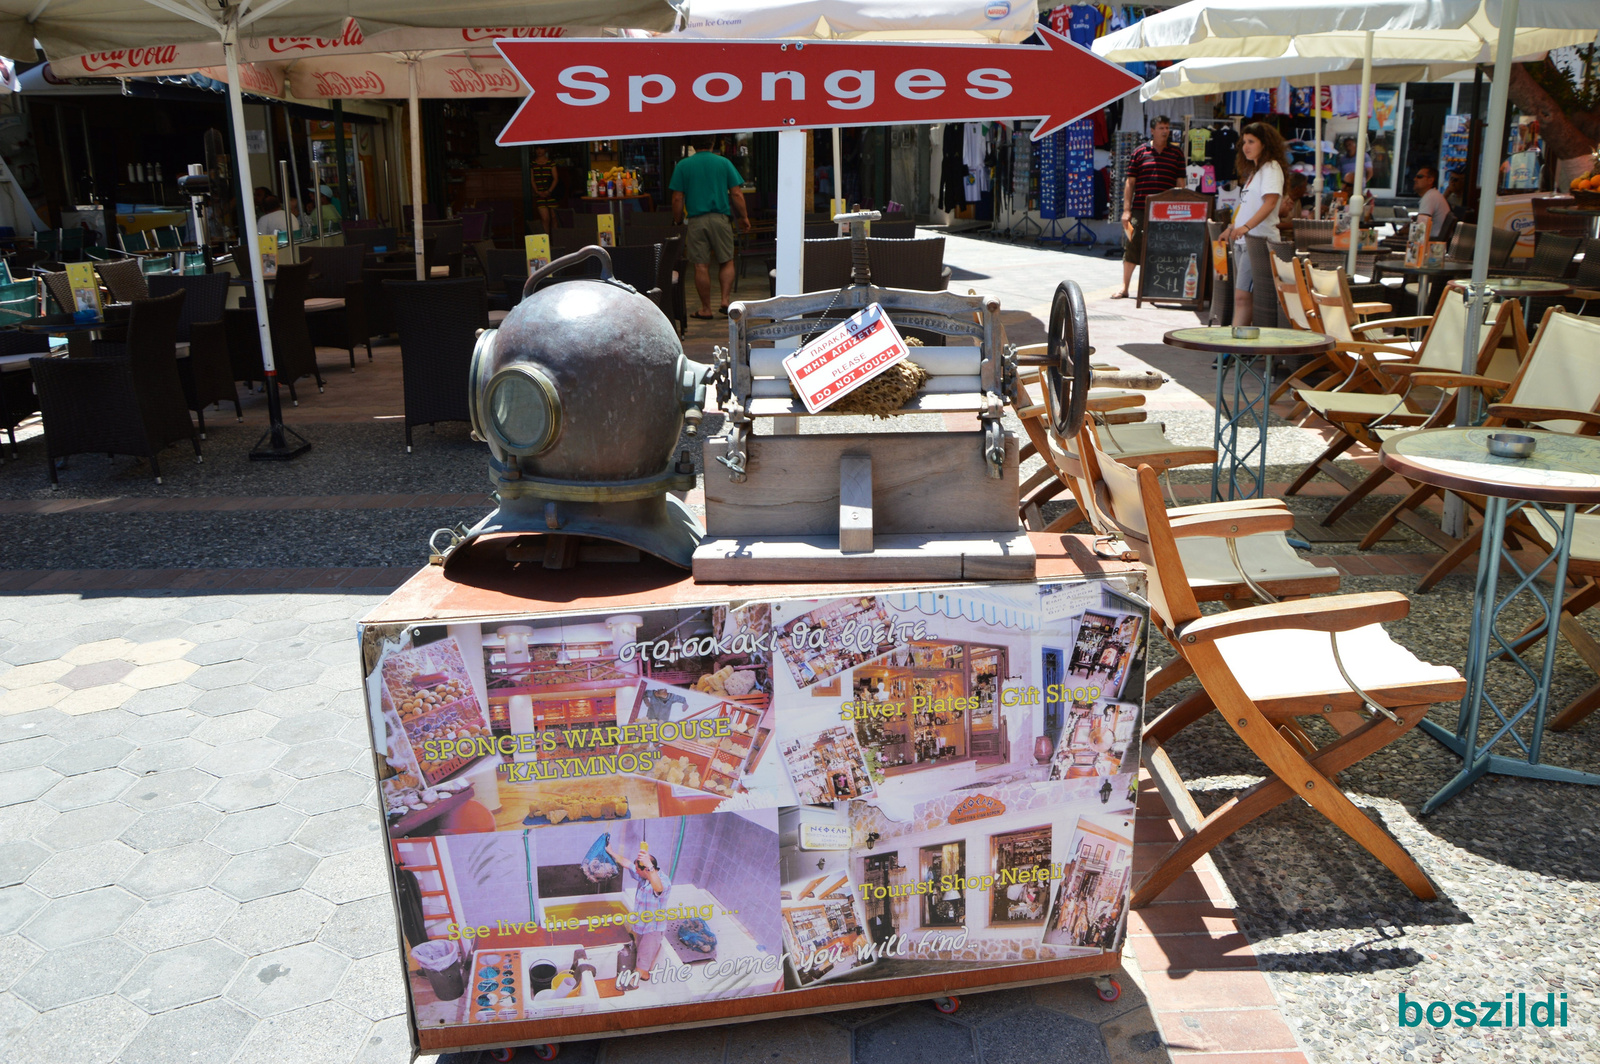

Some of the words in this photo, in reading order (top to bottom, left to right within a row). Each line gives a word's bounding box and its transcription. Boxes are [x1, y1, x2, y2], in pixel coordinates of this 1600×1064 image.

[705, 19, 716, 27] Ice
[716, 17, 742, 27] Cream
[1056, 17, 1065, 32] 9
[556, 64, 1014, 113] Sponges
[1157, 222, 1188, 231] TODAY
[1149, 254, 1174, 264] COLD
[1156, 263, 1185, 274] Beer
[1153, 274, 1179, 292] 2+1
[803, 358, 828, 375] ΜΗΝ
[831, 324, 877, 358] ΑΓΓΙΖΕΤΕ
[810, 324, 859, 357] ΠΑΡΑΚΑΛΩ
[815, 388, 832, 402] DO
[835, 371, 857, 390] NOT
[858, 347, 896, 374] TOUCH
[831, 352, 867, 377] PLEASE
[619, 639, 670, 662] στο
[680, 624, 778, 658] σοκάκι
[789, 620, 830, 650] θα
[841, 700, 906, 720] Silver
[911, 694, 980, 714] Plates
[1001, 686, 1040, 706] Gift
[1046, 683, 1101, 706] Shop
[424, 731, 556, 761] SPONGE'S
[562, 717, 732, 750] WAREHOUSE
[499, 750, 662, 783] "KALYMNOS"
[810, 826, 847, 834] ΝΕΦΕΛΗ
[858, 878, 934, 901] Tourist
[940, 873, 994, 893] Shop
[1000, 862, 1063, 886] Nefeli
[447, 922, 491, 941] See
[496, 917, 538, 937] live
[543, 914, 580, 933] the
[586, 902, 714, 932] processing
[616, 964, 640, 990] in
[648, 956, 692, 985] the
[704, 950, 791, 979] corner
[799, 949, 845, 974] you
[857, 928, 907, 961] will
[917, 925, 978, 953] find...
